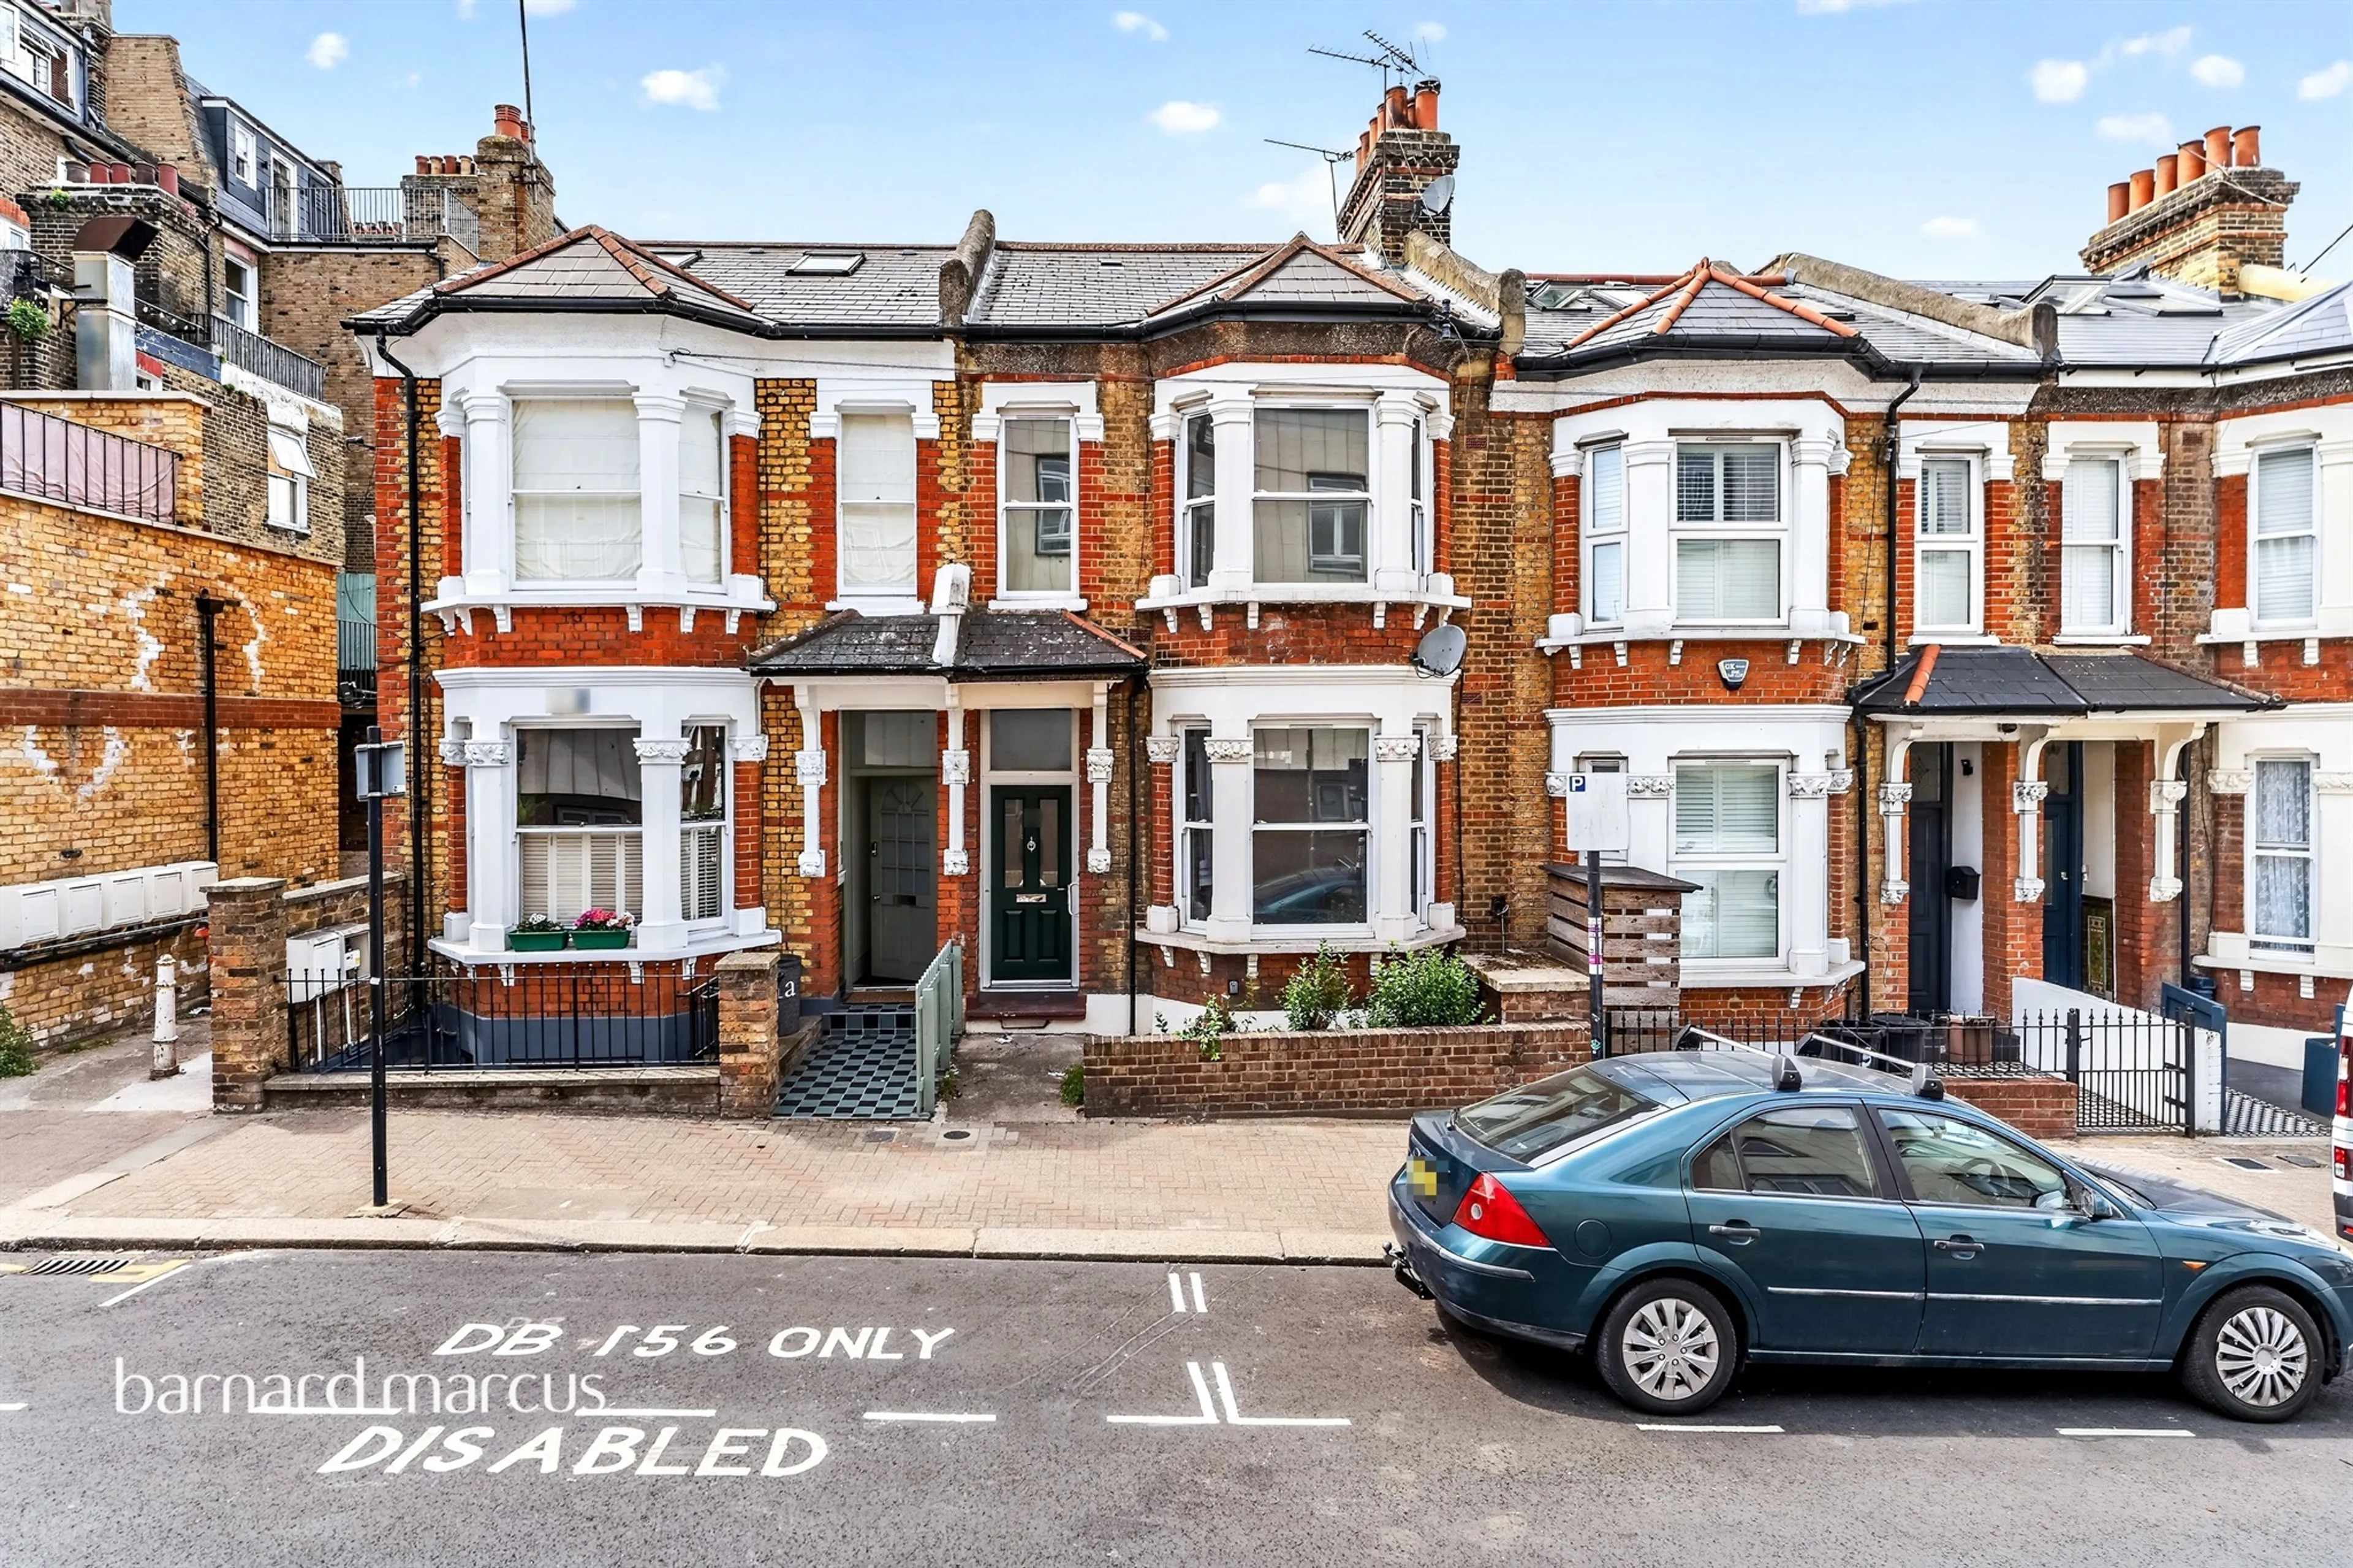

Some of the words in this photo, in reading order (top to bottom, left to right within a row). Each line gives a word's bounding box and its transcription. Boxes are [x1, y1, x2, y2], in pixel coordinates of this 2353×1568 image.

[1572, 776, 1583, 791] P
[431, 1323, 563, 1355] DB
[592, 1325, 737, 1357] 156
[768, 1327, 956, 1359] ONLY
[316, 1426, 828, 1477] DISABLED
